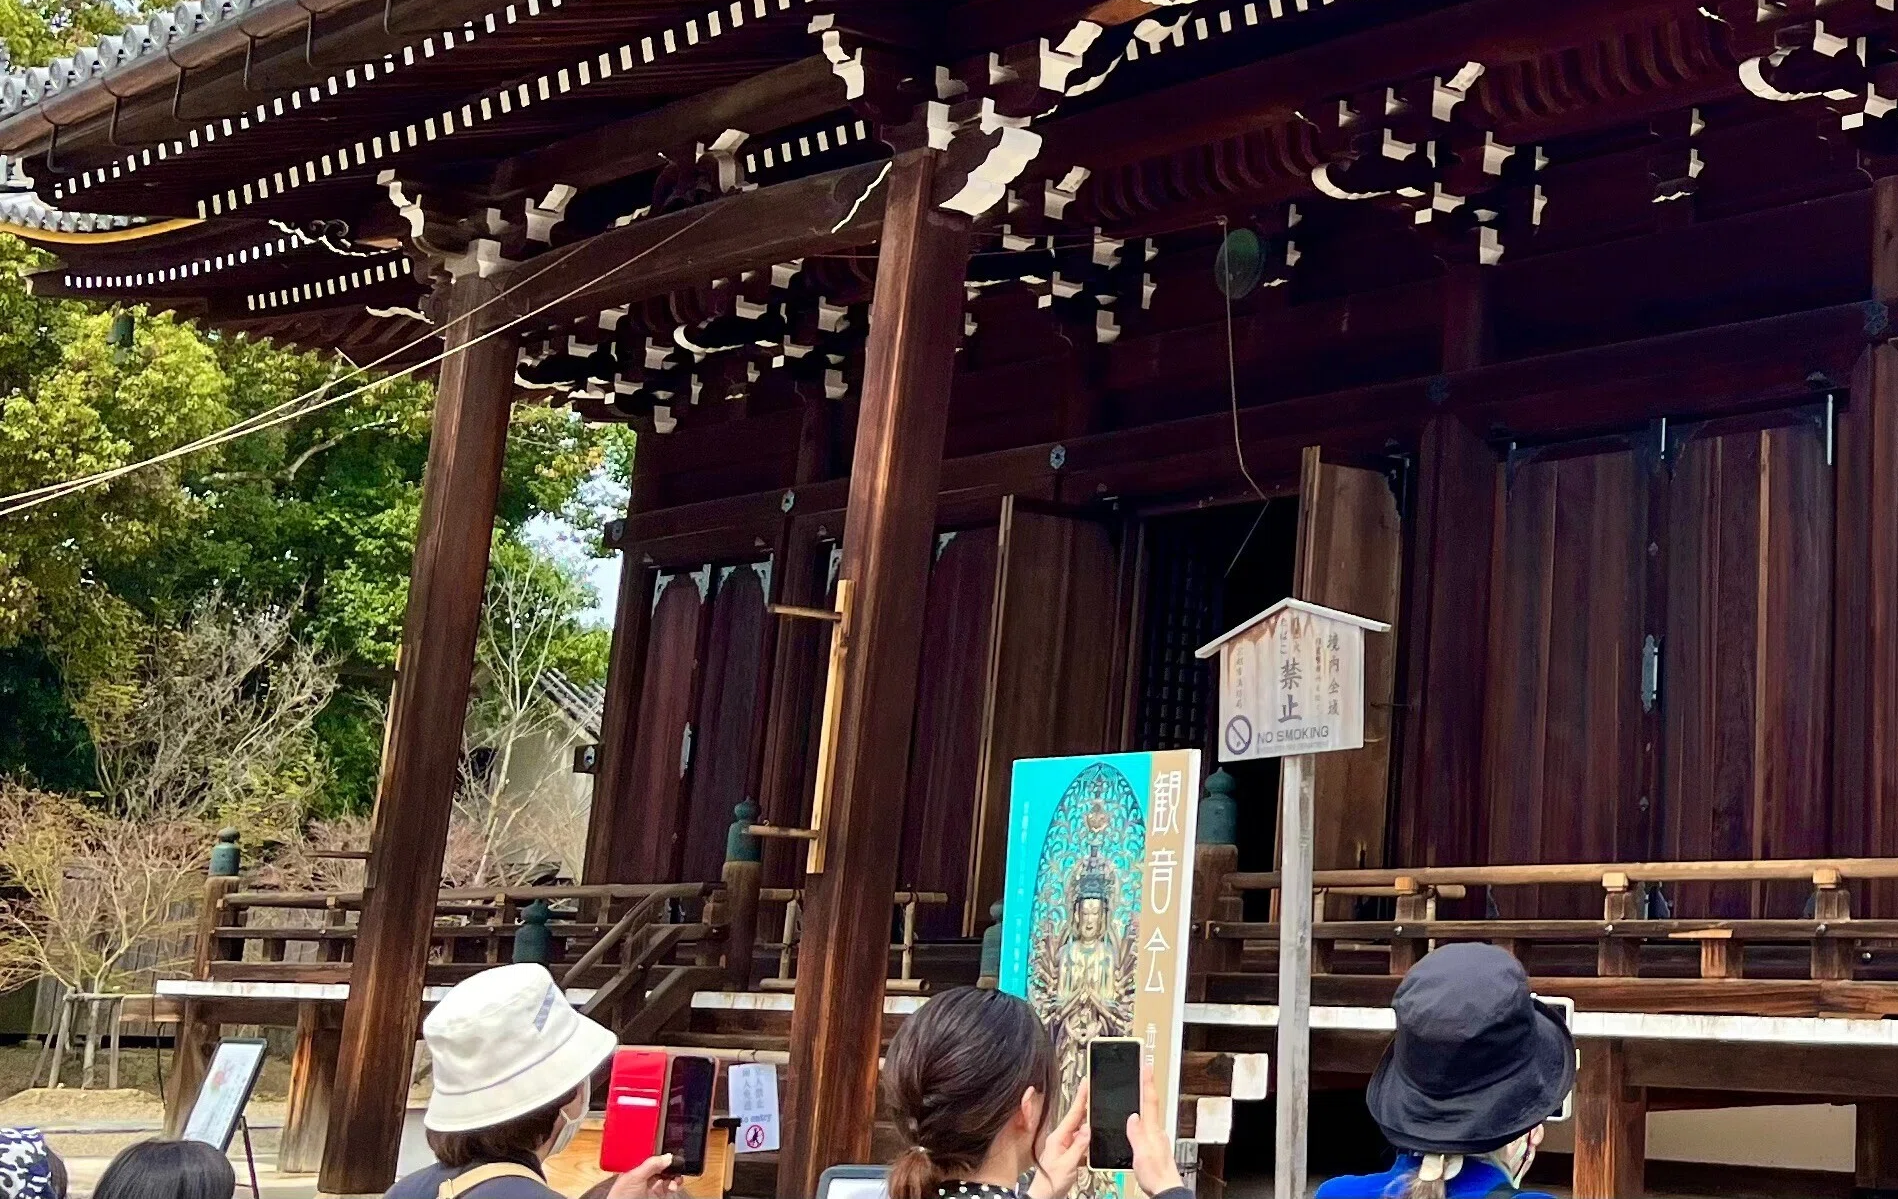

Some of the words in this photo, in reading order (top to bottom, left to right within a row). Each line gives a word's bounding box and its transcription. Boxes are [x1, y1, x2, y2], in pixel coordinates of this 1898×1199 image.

[1278, 657, 1302, 723] 禁止
[1327, 632, 1340, 715] 境内全域
[1257, 731, 1273, 743] NO
[1276, 725, 1329, 742] SMOKING
[1143, 770, 1182, 994] 観音会
